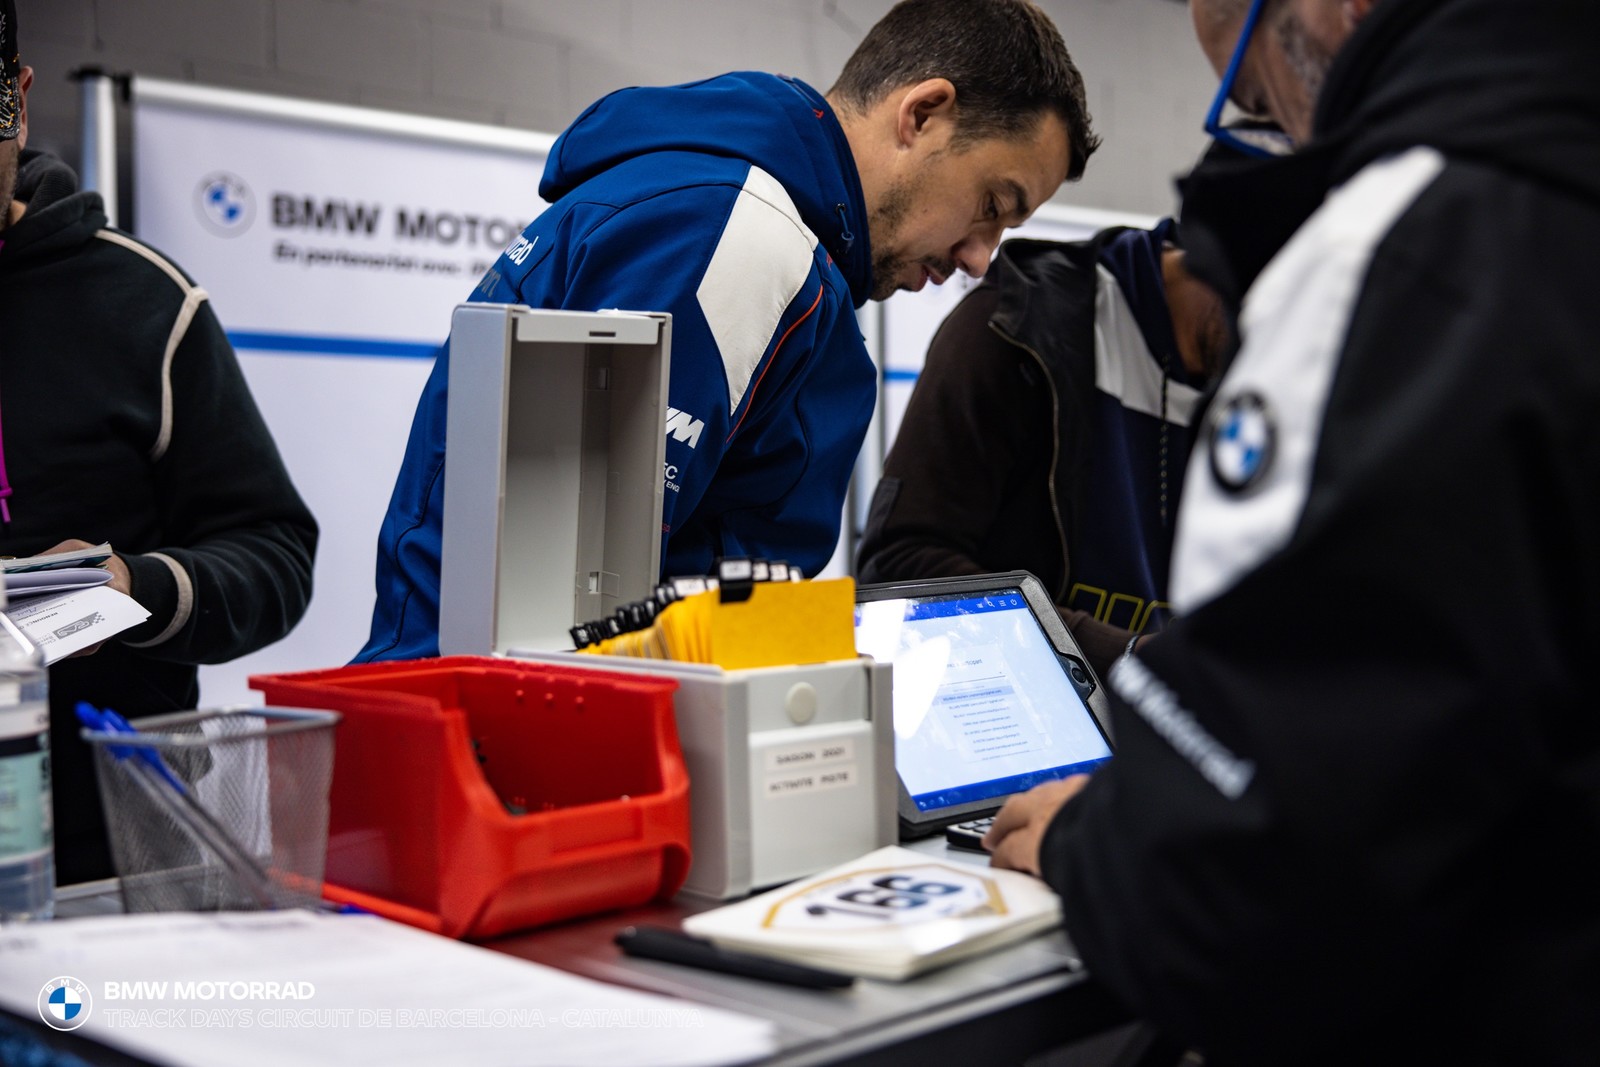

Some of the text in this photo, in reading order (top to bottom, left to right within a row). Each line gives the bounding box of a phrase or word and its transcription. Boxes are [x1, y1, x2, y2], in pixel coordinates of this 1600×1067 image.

[272, 194, 520, 250] BMW MOTO
[806, 874, 964, 920] 166
